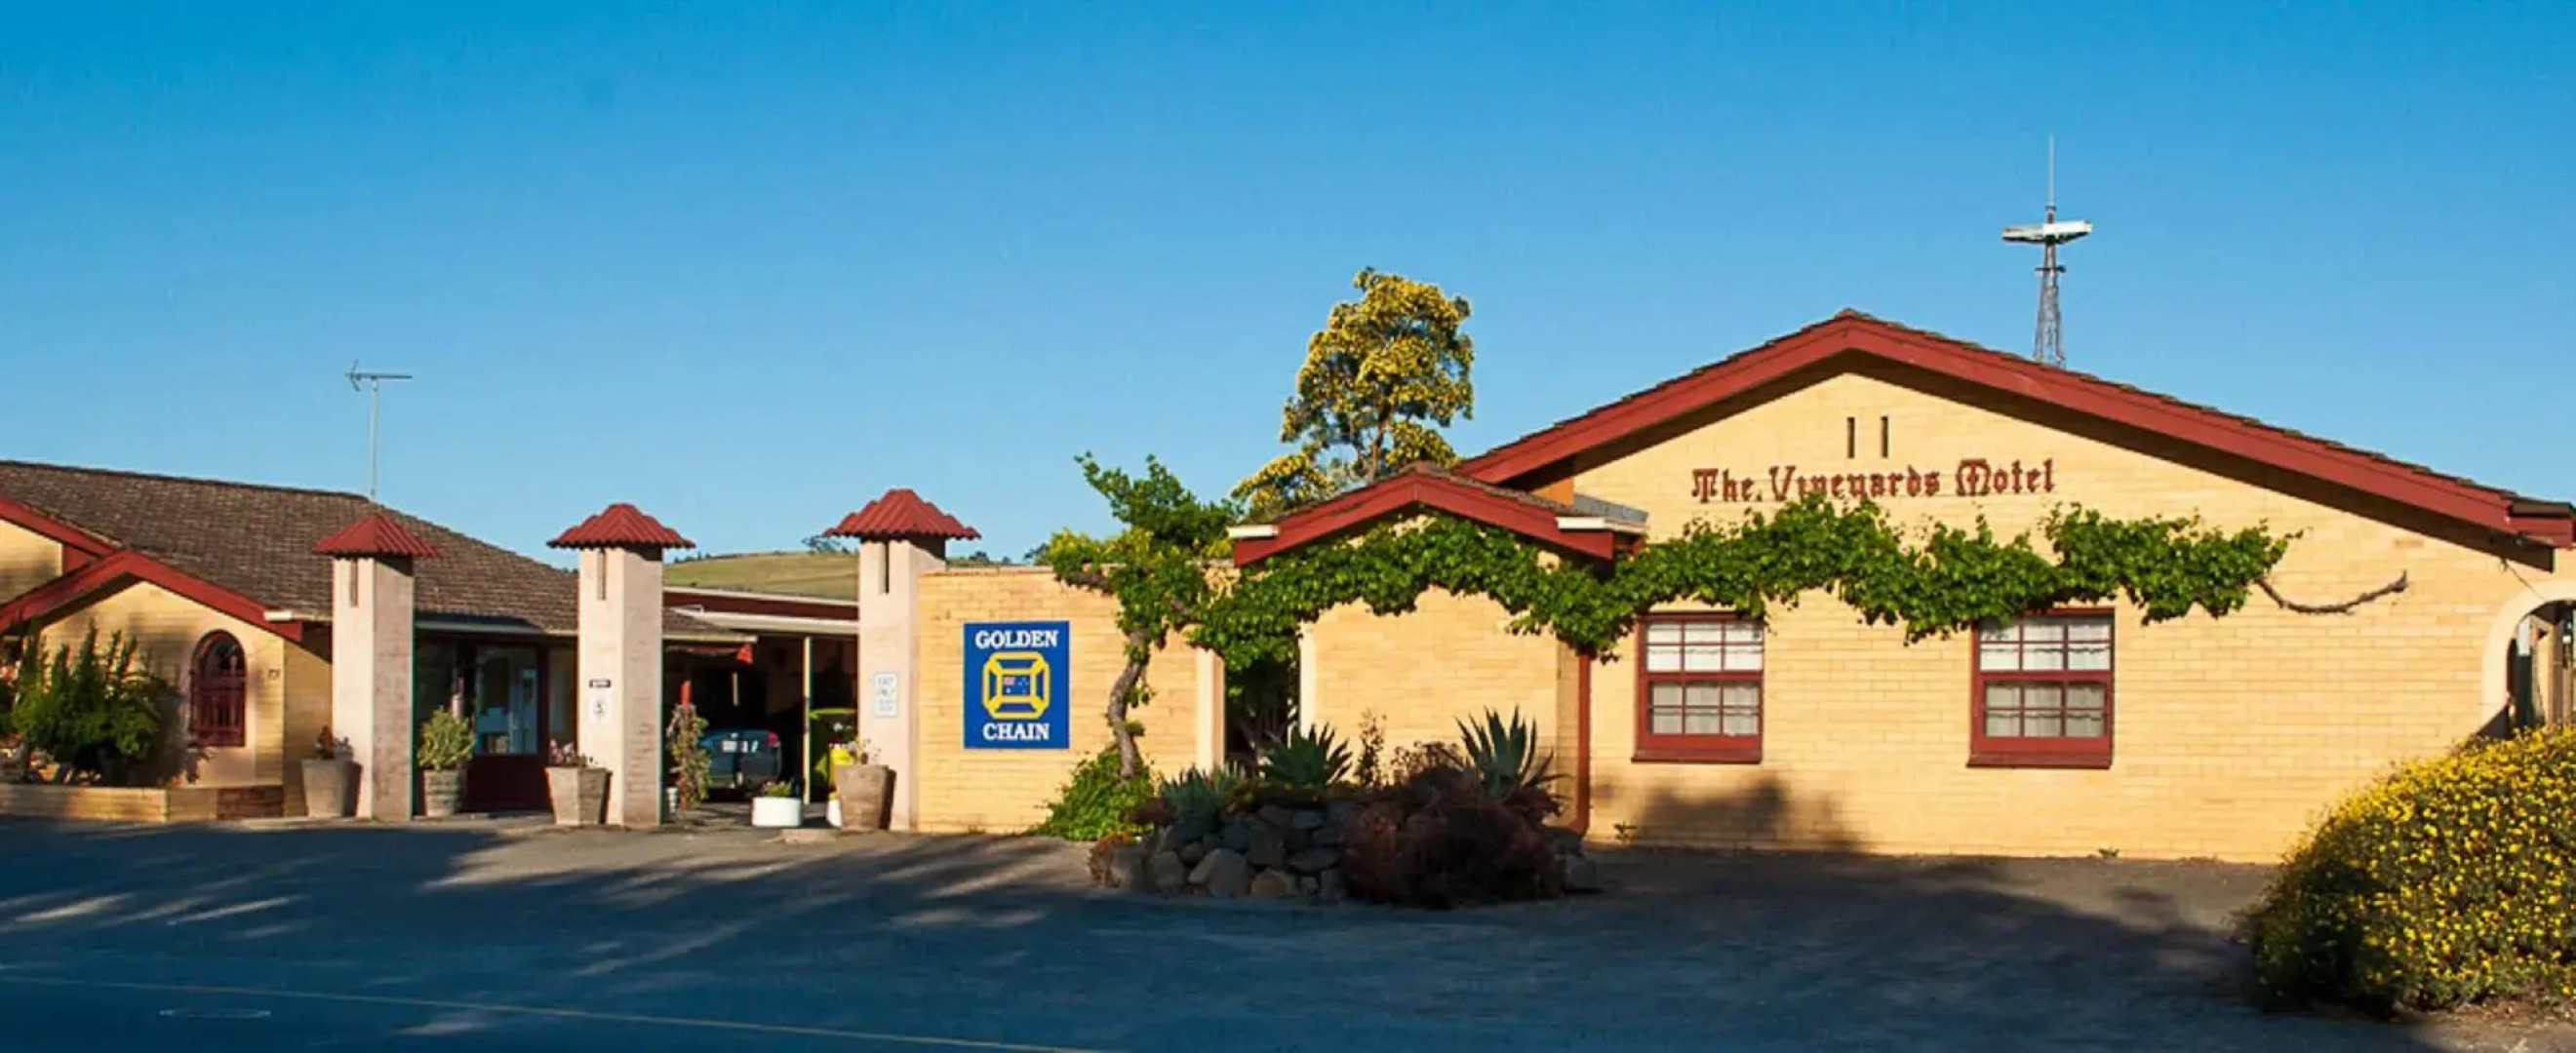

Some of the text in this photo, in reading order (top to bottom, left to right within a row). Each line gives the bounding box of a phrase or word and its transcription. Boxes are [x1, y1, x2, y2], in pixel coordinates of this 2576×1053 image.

[1768, 465, 1940, 501] Vineyards
[1956, 458, 2055, 496] Motel
[975, 630, 1058, 649] GOLDEN
[982, 722, 1050, 740] CHAIN
